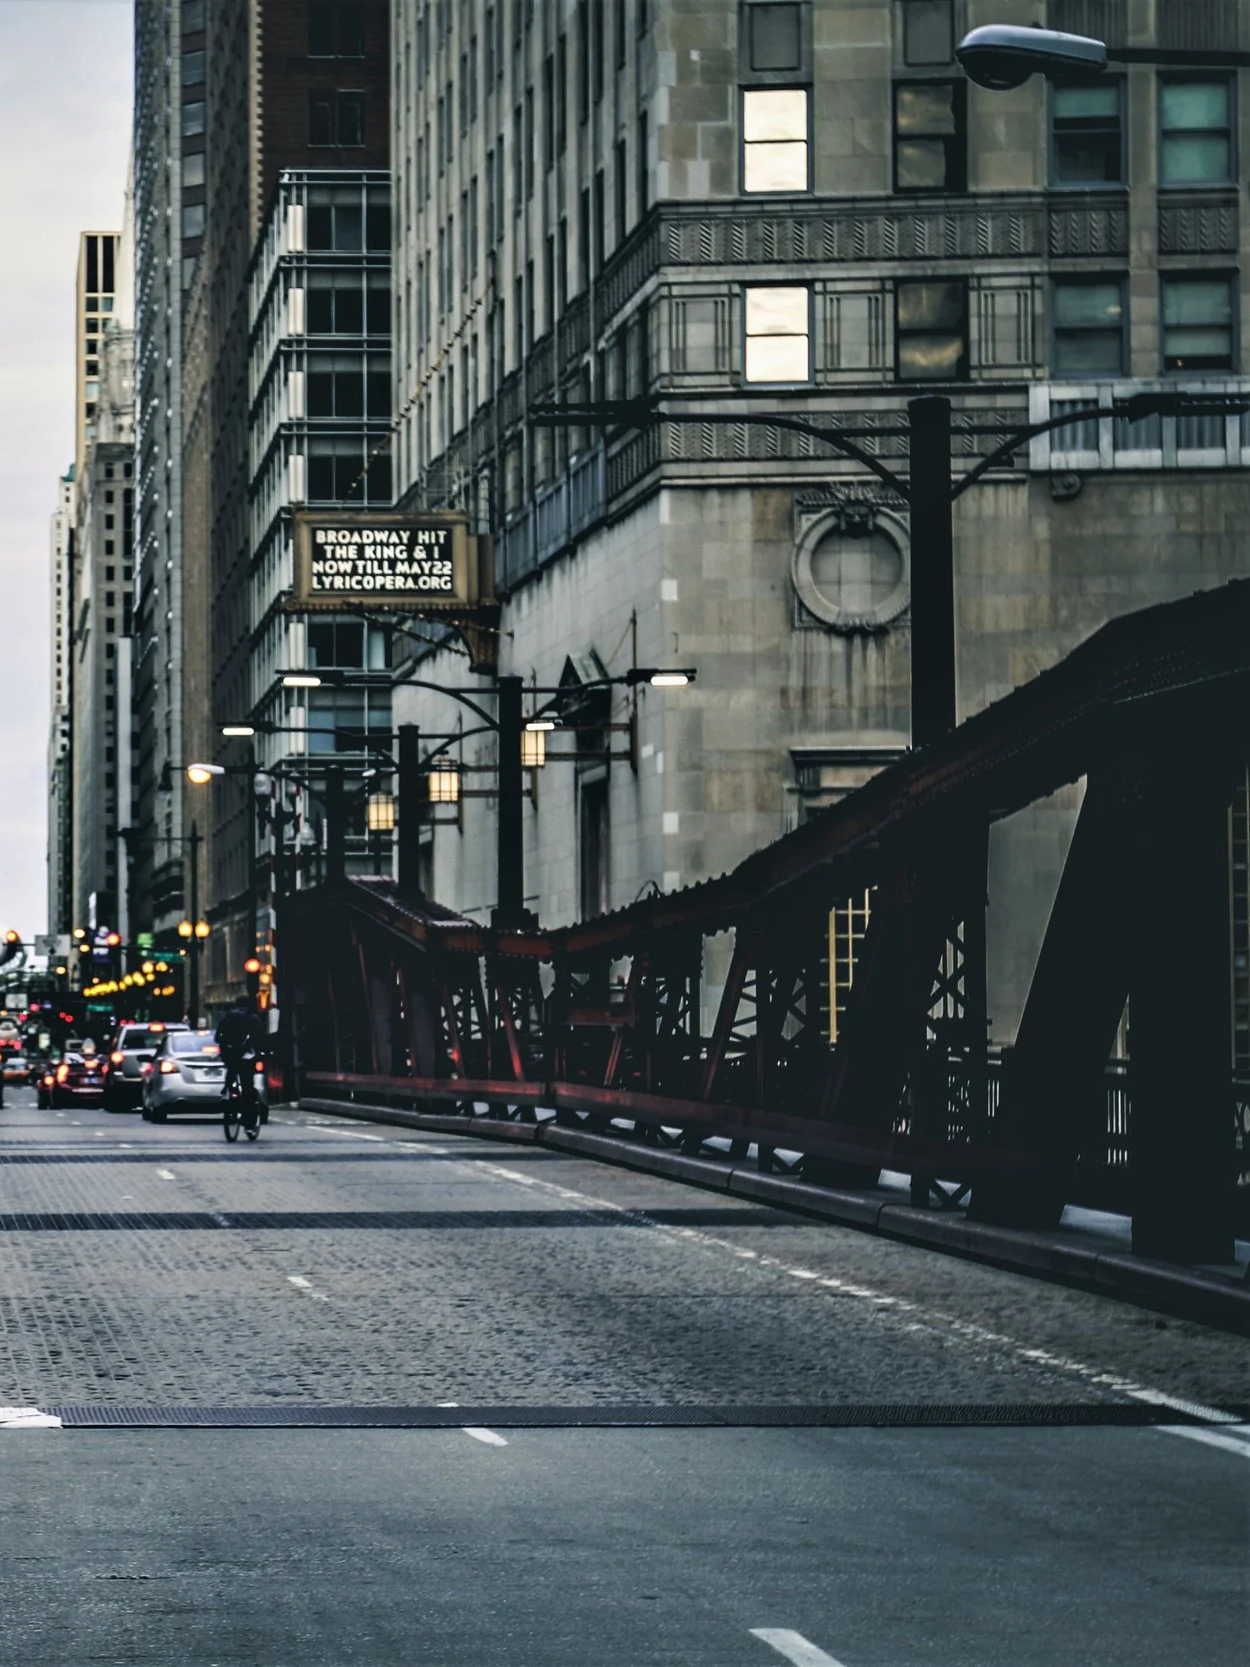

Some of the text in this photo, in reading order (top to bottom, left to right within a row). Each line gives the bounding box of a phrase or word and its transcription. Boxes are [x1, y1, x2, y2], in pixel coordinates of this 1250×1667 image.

[316, 530, 447, 544] BROADWAY HIT
[324, 545, 440, 560] THE KING & I
[312, 560, 353, 574] NOW
[355, 560, 393, 574] TILL
[312, 576, 452, 590] LYRICOPERA.ORG
